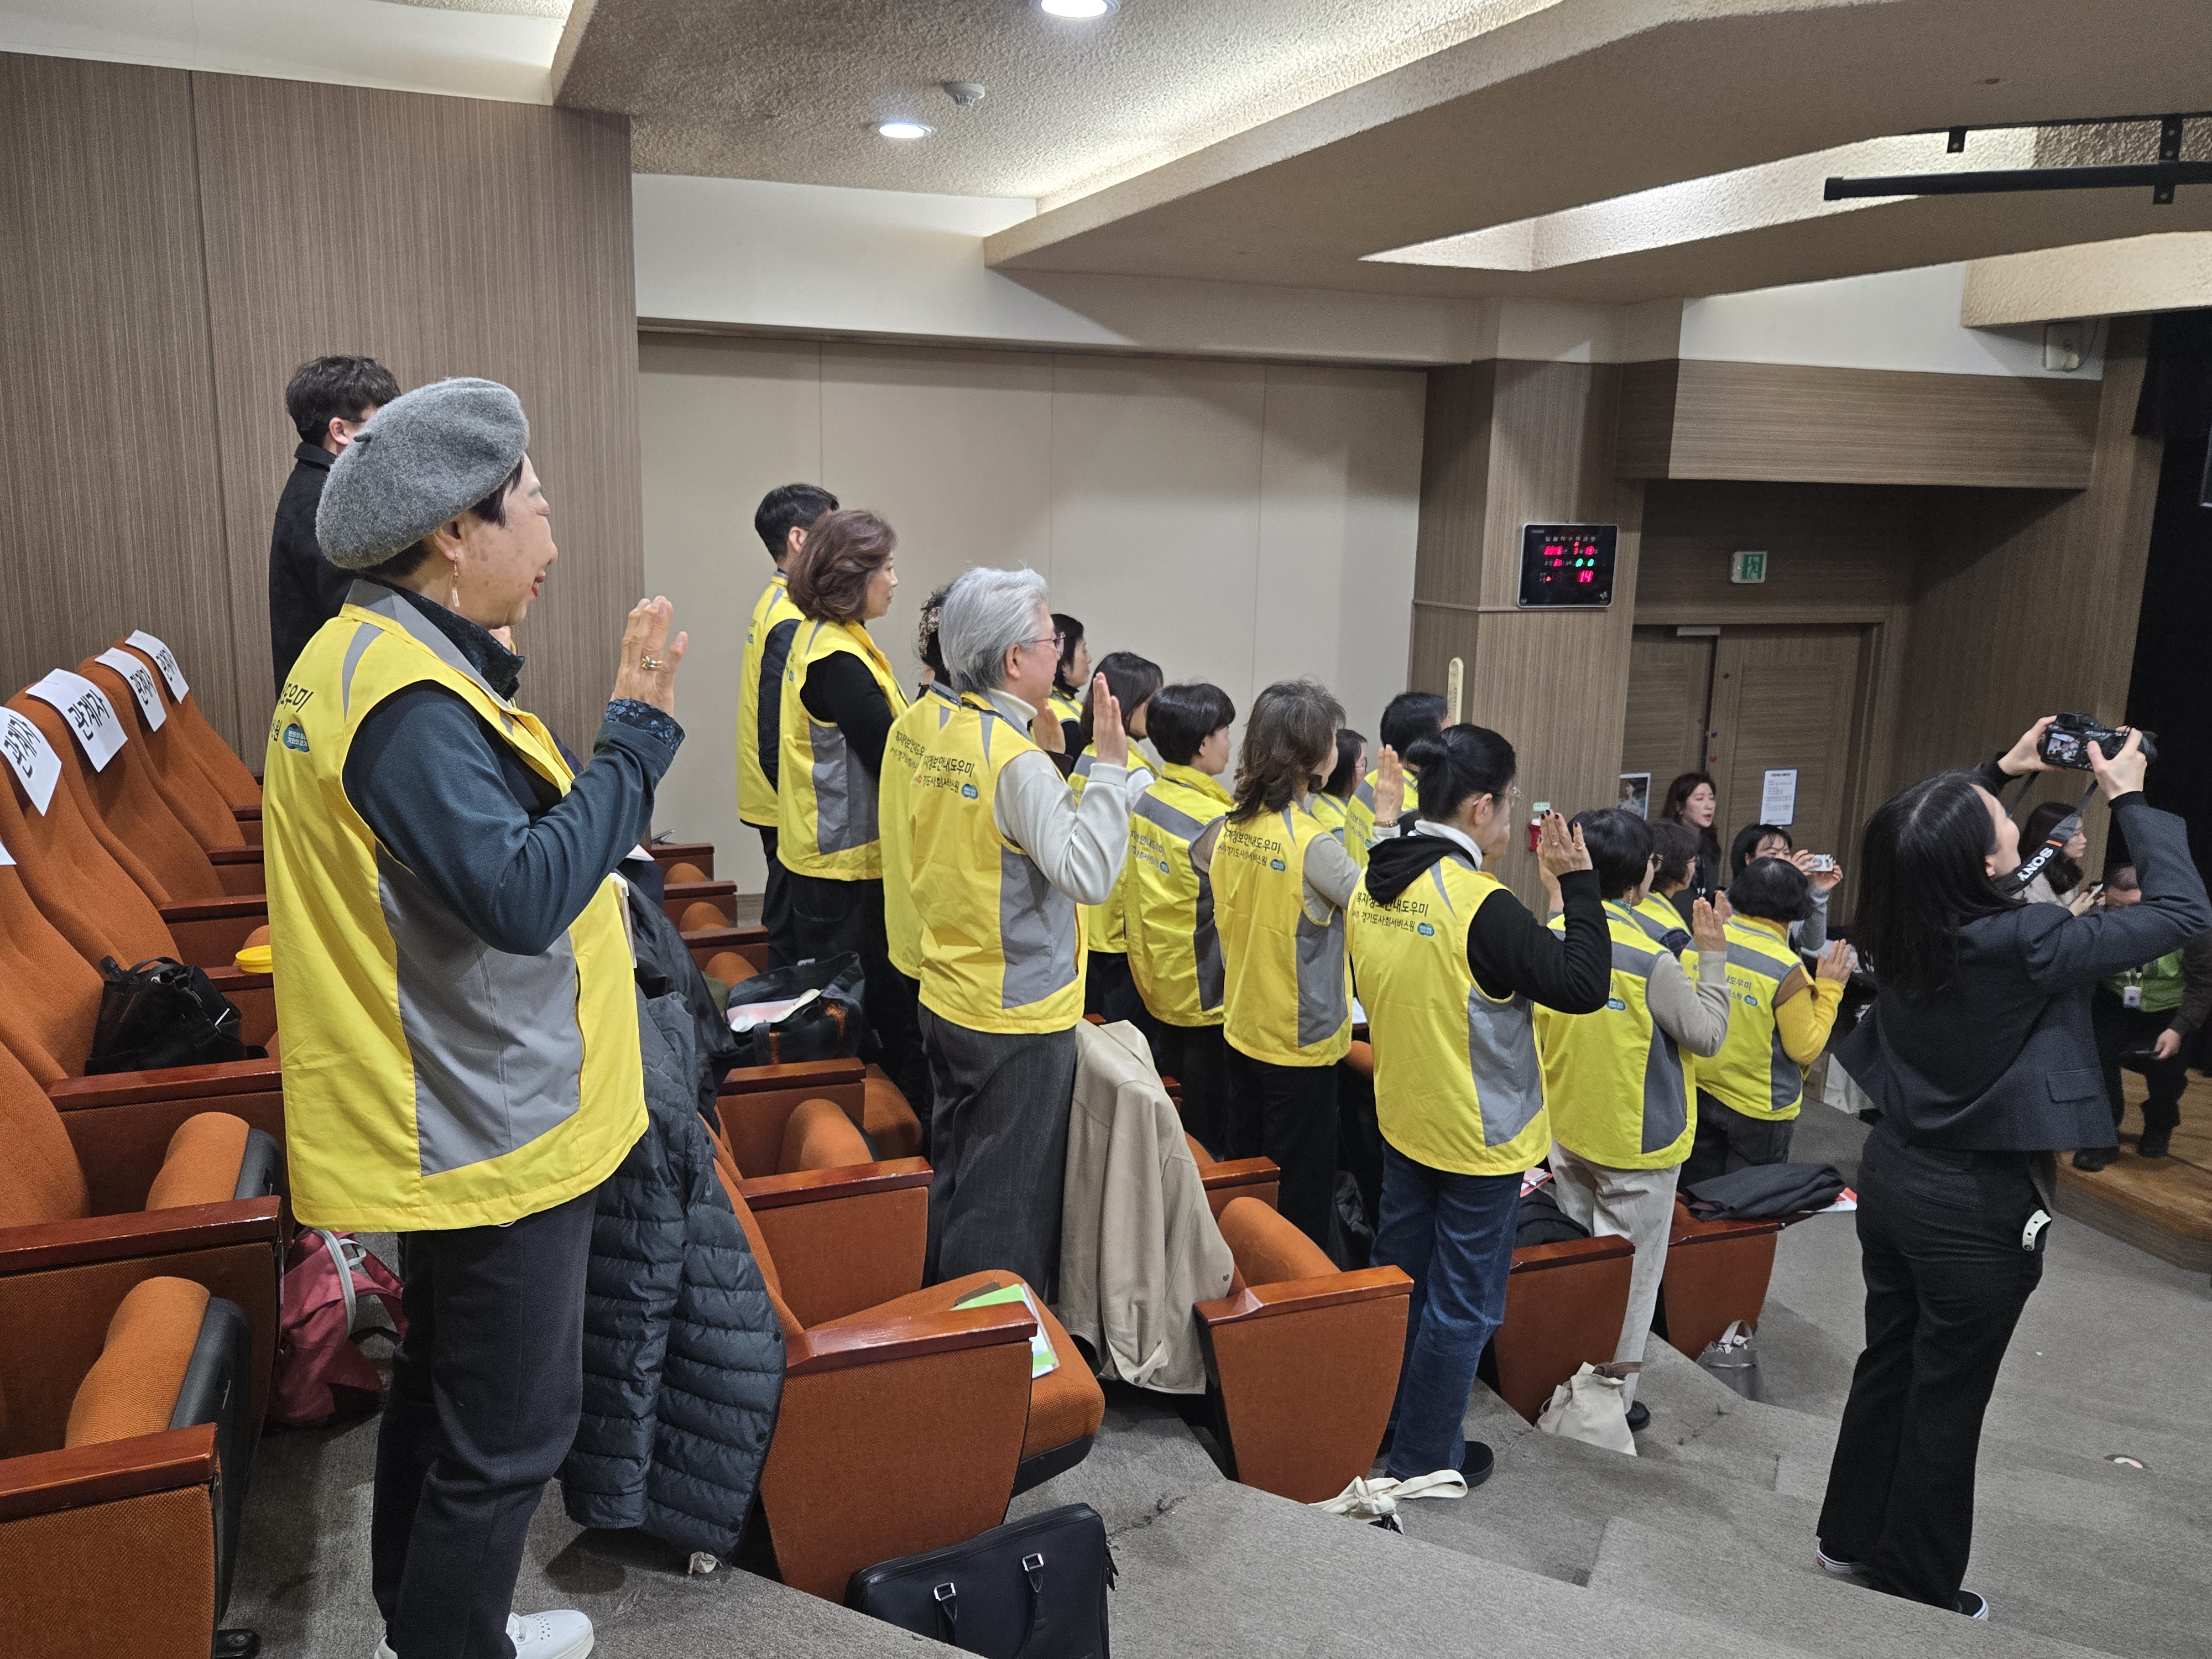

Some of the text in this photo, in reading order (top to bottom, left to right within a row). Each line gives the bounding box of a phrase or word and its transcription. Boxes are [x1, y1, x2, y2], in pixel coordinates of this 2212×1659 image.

[155, 646, 178, 682] 관계자
[129, 666, 156, 706] 관계자
[278, 681, 315, 713] 도우미
[67, 688, 110, 741] 관계자
[4, 714, 41, 779] 관계자
[2016, 847, 2054, 882] SONY
[1361, 911, 1416, 932] 경기도사회서비스원
